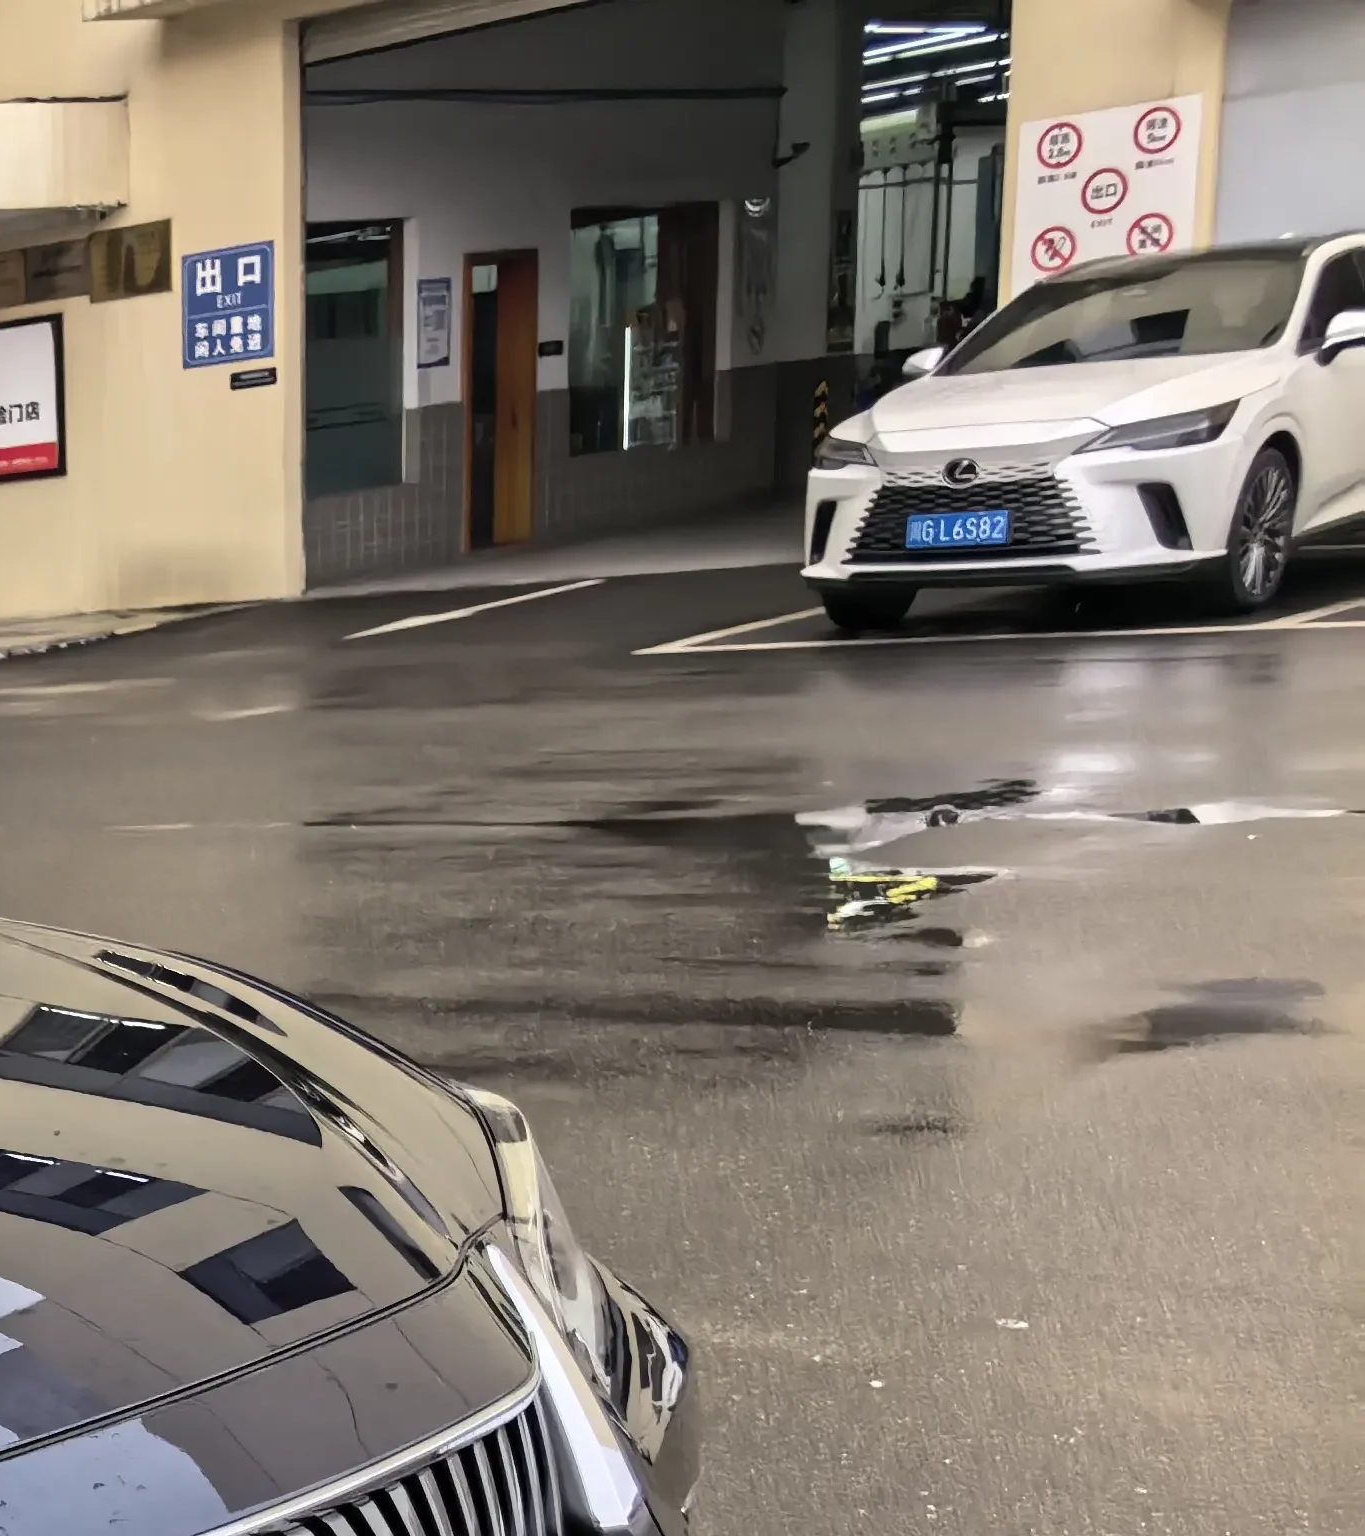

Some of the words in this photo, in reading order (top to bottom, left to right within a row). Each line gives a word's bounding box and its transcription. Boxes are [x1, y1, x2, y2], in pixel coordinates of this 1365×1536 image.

[1090, 182, 1118, 200] 出口
[195, 254, 262, 297] 出口
[216, 291, 242, 309] EXIT
